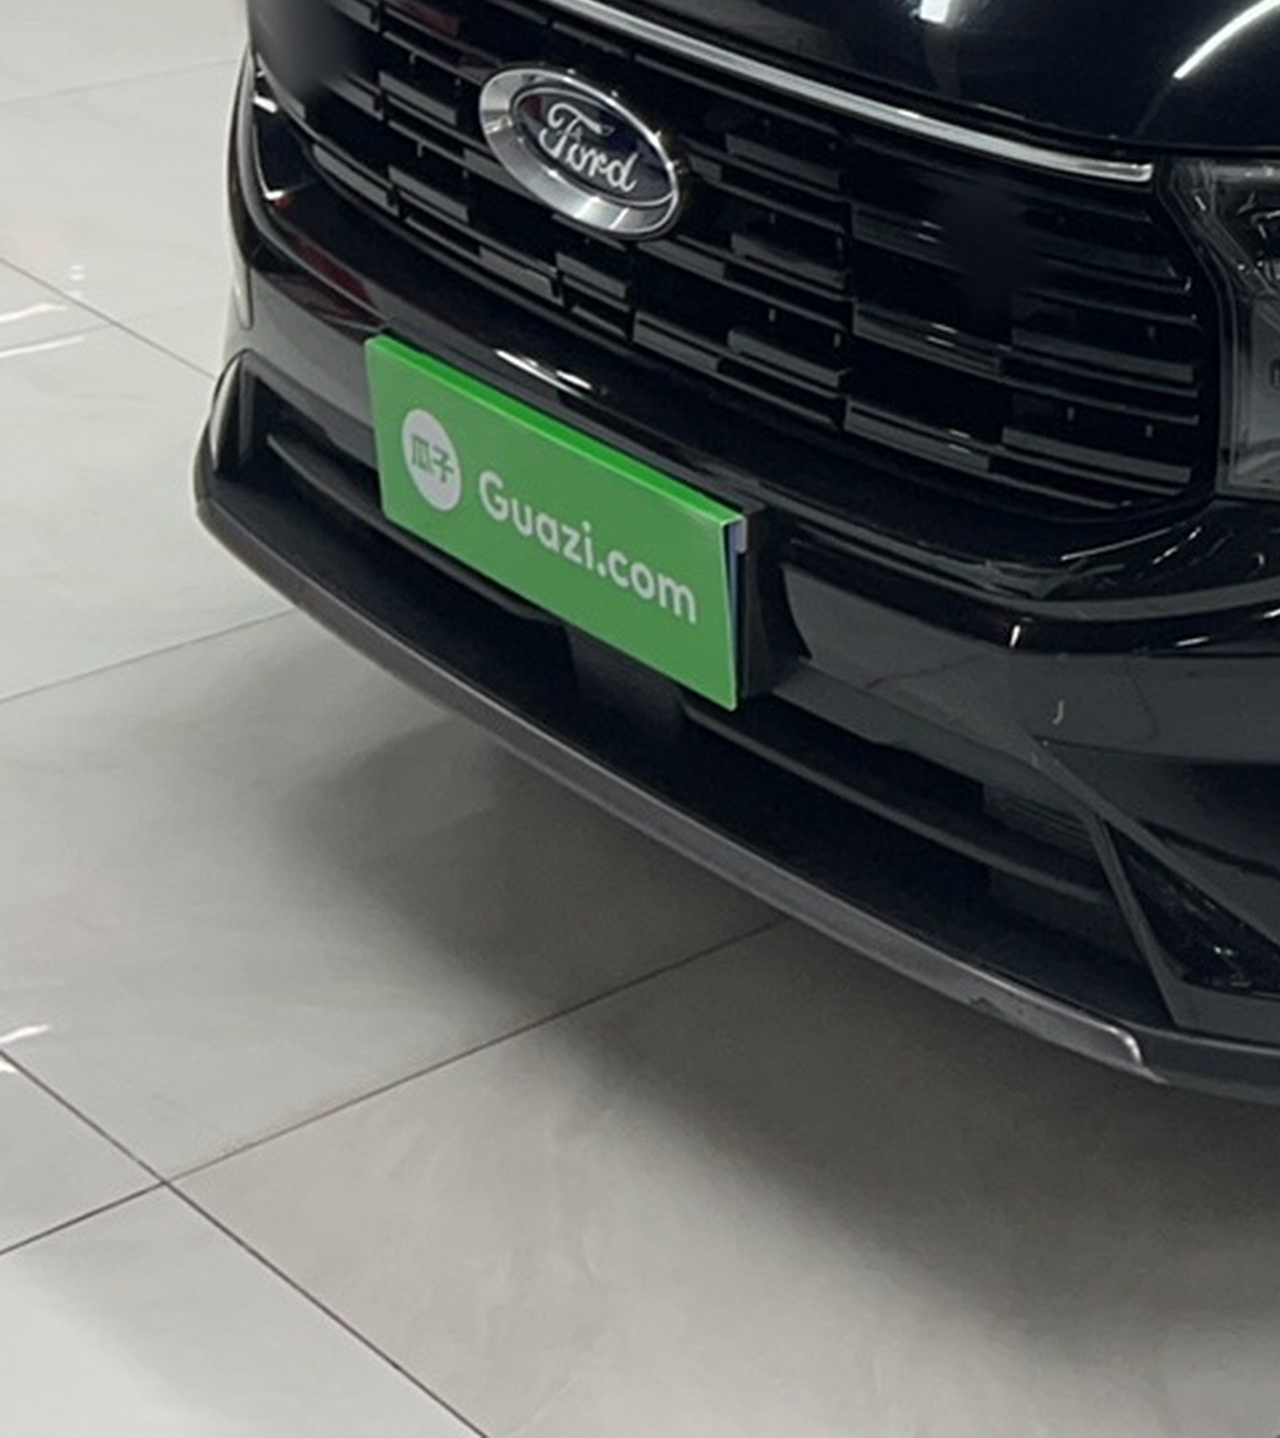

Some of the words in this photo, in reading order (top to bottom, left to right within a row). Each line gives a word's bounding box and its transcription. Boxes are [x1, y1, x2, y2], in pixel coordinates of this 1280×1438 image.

[538, 102, 639, 192] Ford
[410, 431, 456, 484] 瓜子
[478, 469, 697, 626] Guazi.com
